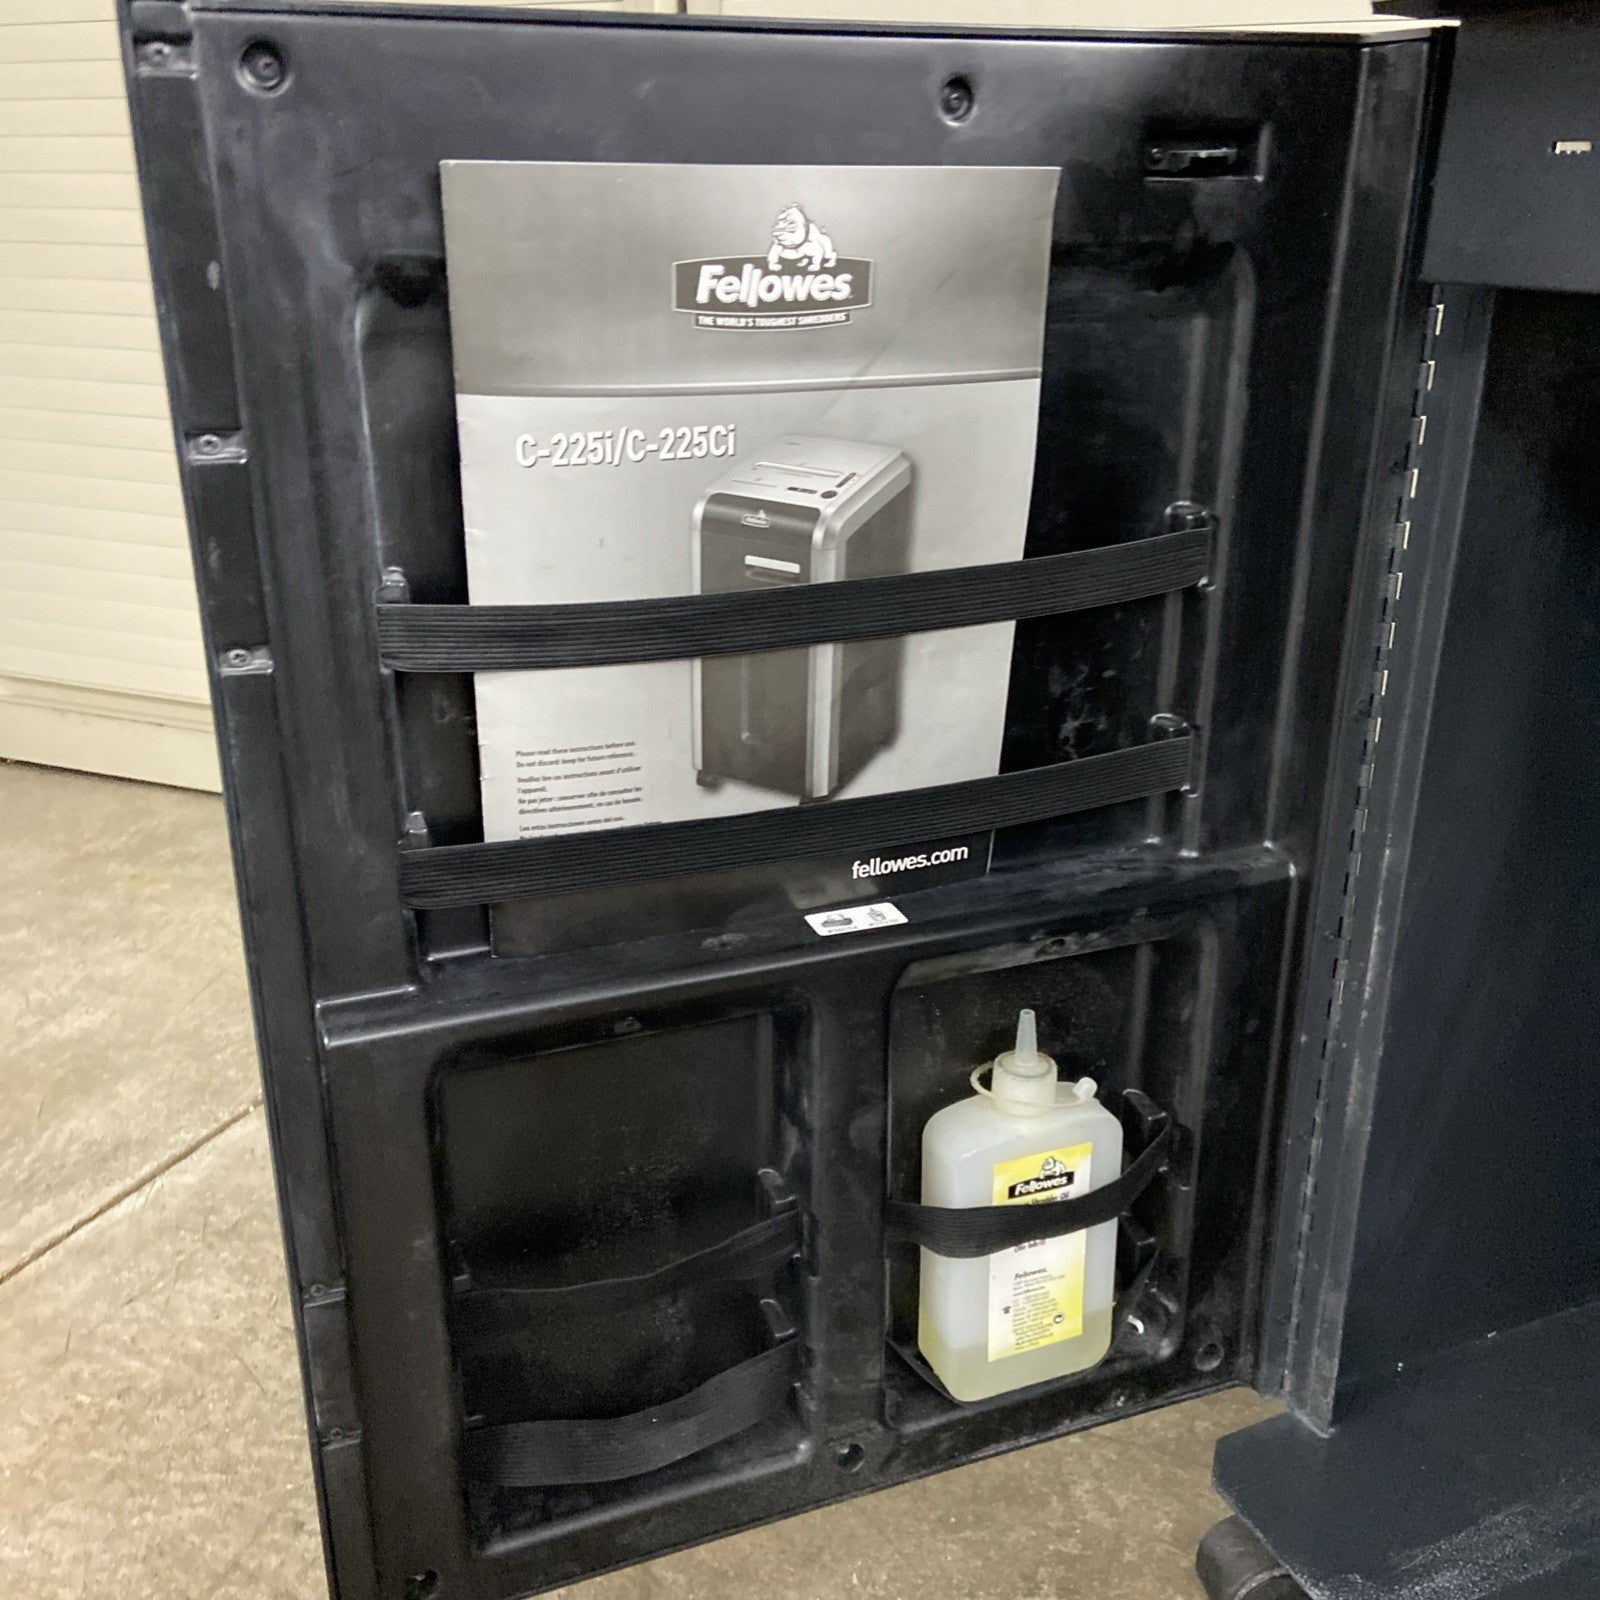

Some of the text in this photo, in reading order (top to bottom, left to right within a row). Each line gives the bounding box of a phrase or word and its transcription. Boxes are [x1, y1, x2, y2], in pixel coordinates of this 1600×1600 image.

[695, 263, 853, 308] Fellowes
[698, 315, 715, 326] THE
[515, 423, 736, 468] C-225i/C-225Ci
[851, 846, 969, 879] fellowes.com
[1015, 1175, 1068, 1196] Fellowes
